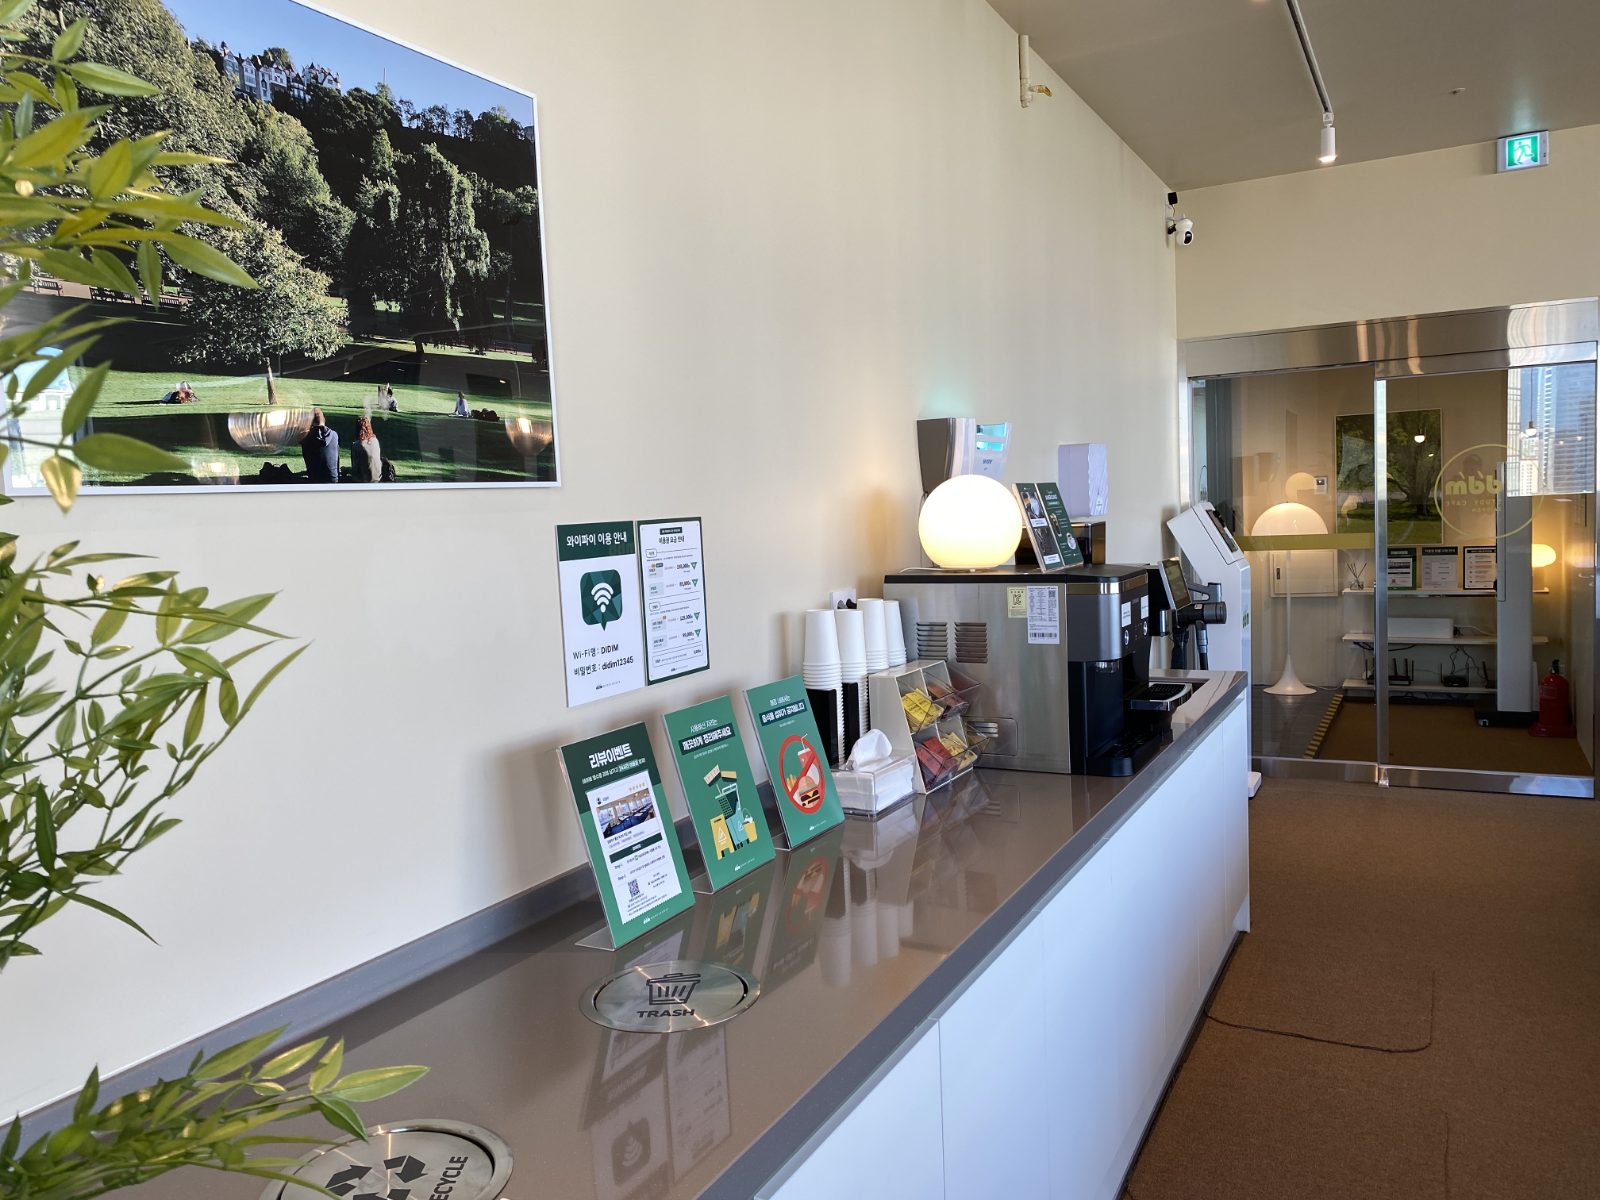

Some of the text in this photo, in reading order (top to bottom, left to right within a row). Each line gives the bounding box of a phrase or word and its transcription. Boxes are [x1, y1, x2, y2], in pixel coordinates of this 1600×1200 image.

[566, 531, 628, 548] 와이파이 이용 안내
[573, 647, 596, 660] Wi-Fi명
[600, 643, 619, 655] DIDIM
[574, 663, 598, 676] 비밀번호
[602, 656, 634, 670] didim12345
[682, 726, 732, 751] 깨끗하게 정리해주세요
[588, 743, 633, 769] 리뷰이벤트
[636, 1008, 695, 1018] TRASH
[428, 1156, 469, 1200] ECYCLE
